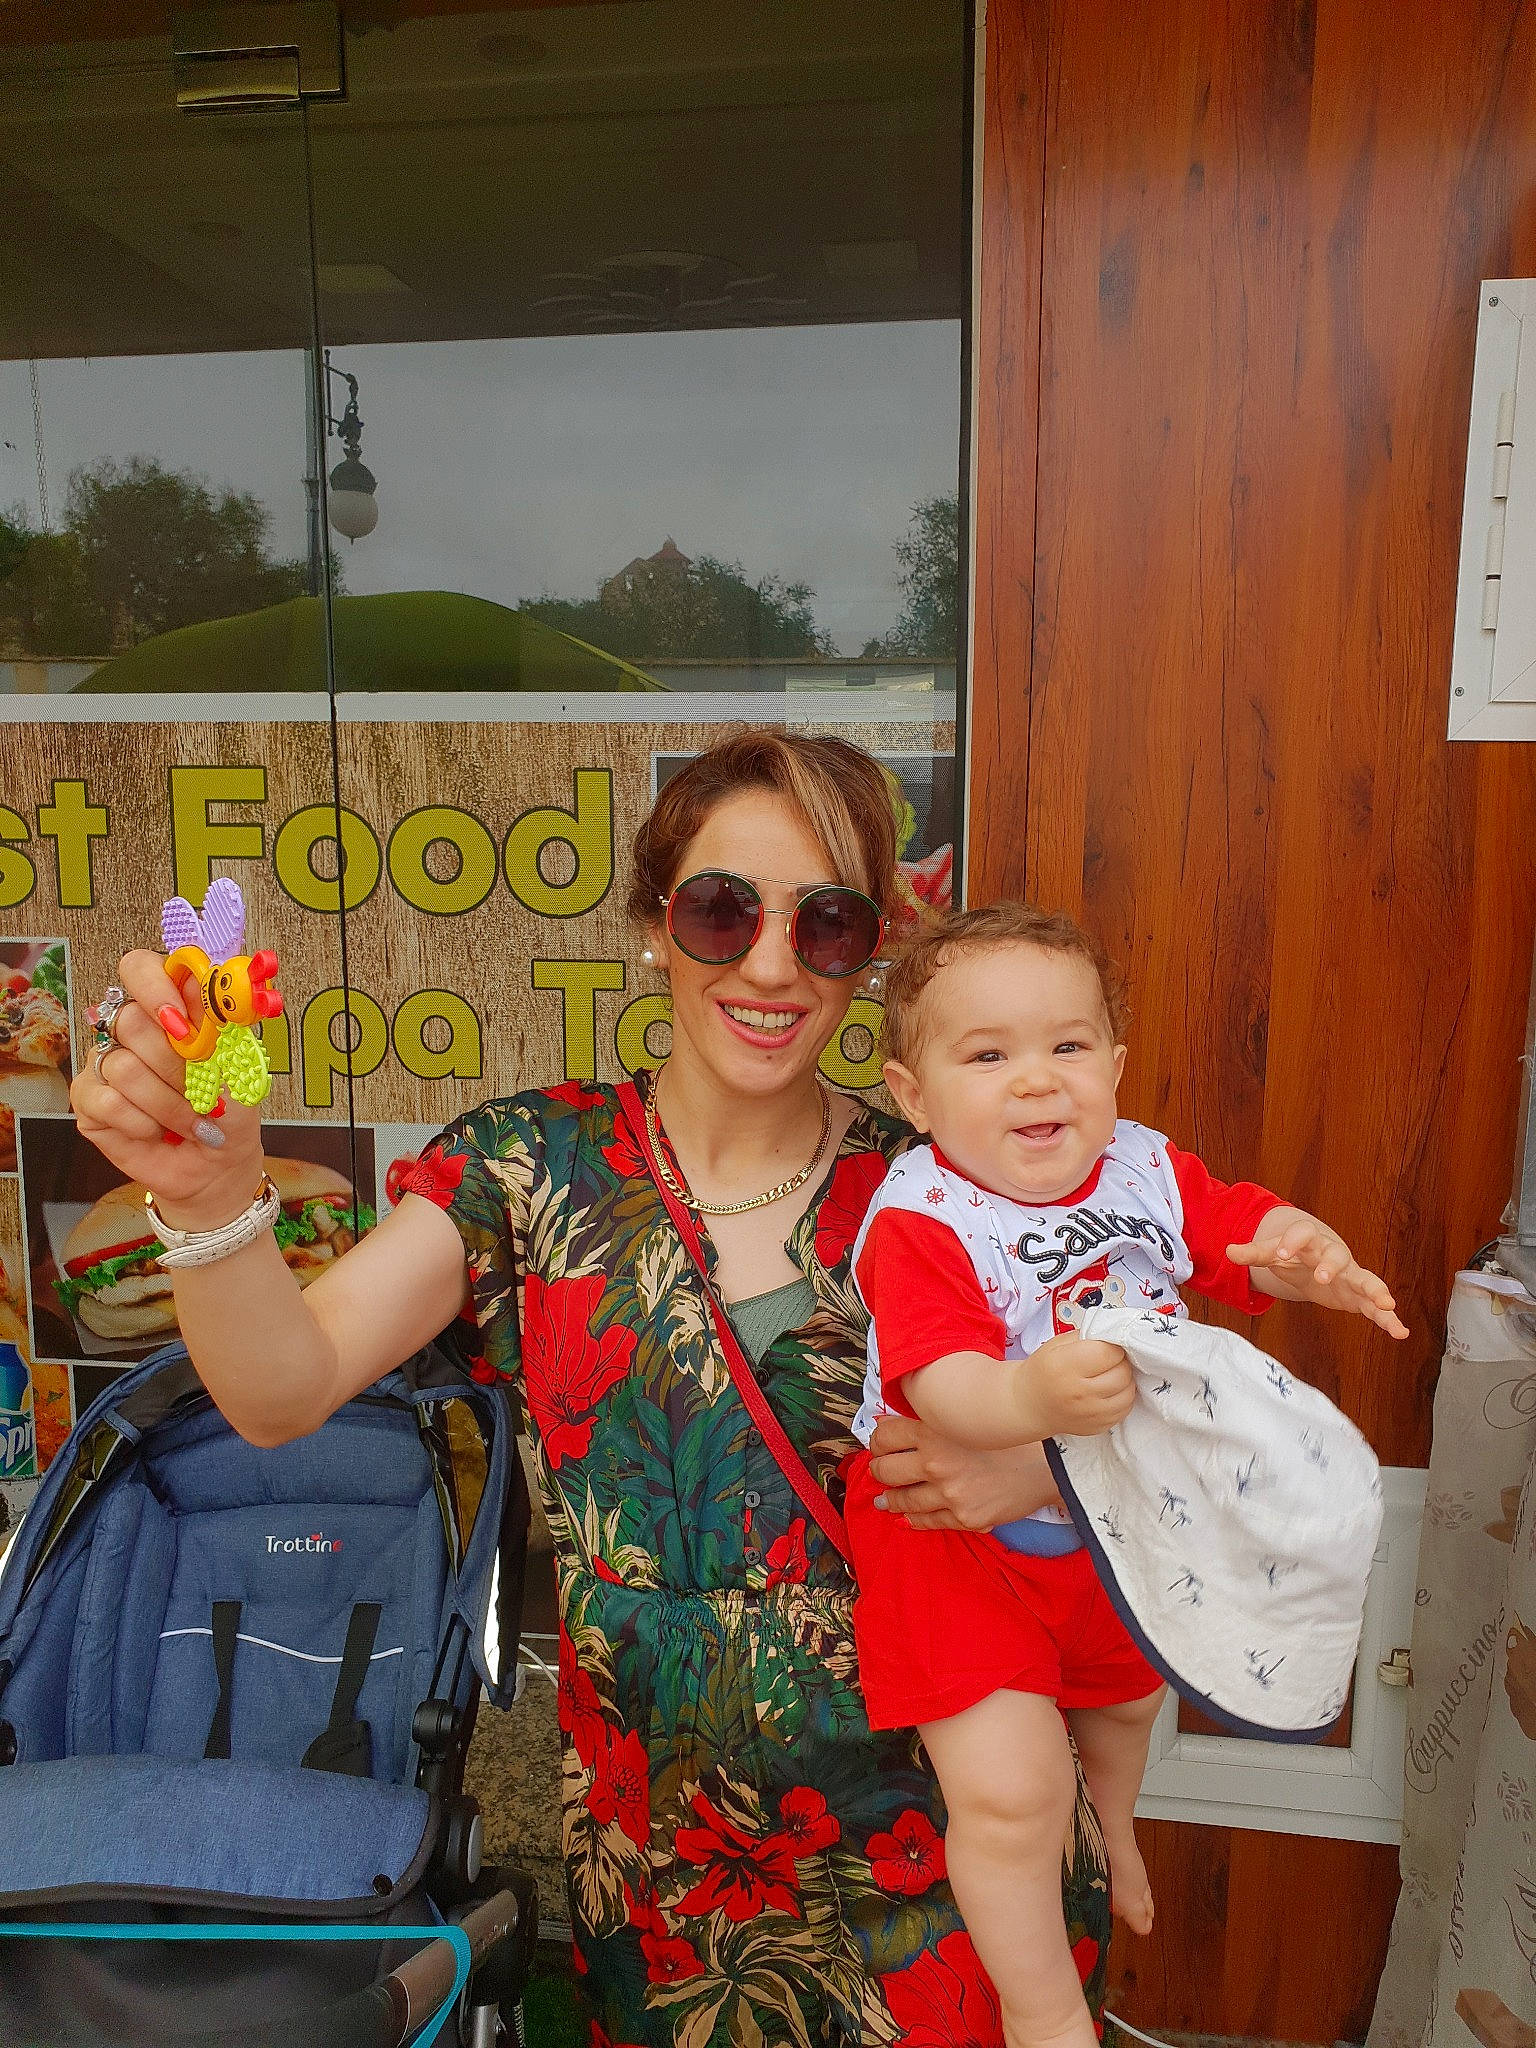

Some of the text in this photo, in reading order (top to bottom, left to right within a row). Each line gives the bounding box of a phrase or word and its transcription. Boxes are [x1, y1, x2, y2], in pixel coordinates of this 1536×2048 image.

[169, 765, 615, 919] Food
[265, 1532, 344, 1553] Trottine
[1404, 1621, 1499, 1794] Cappuccino
